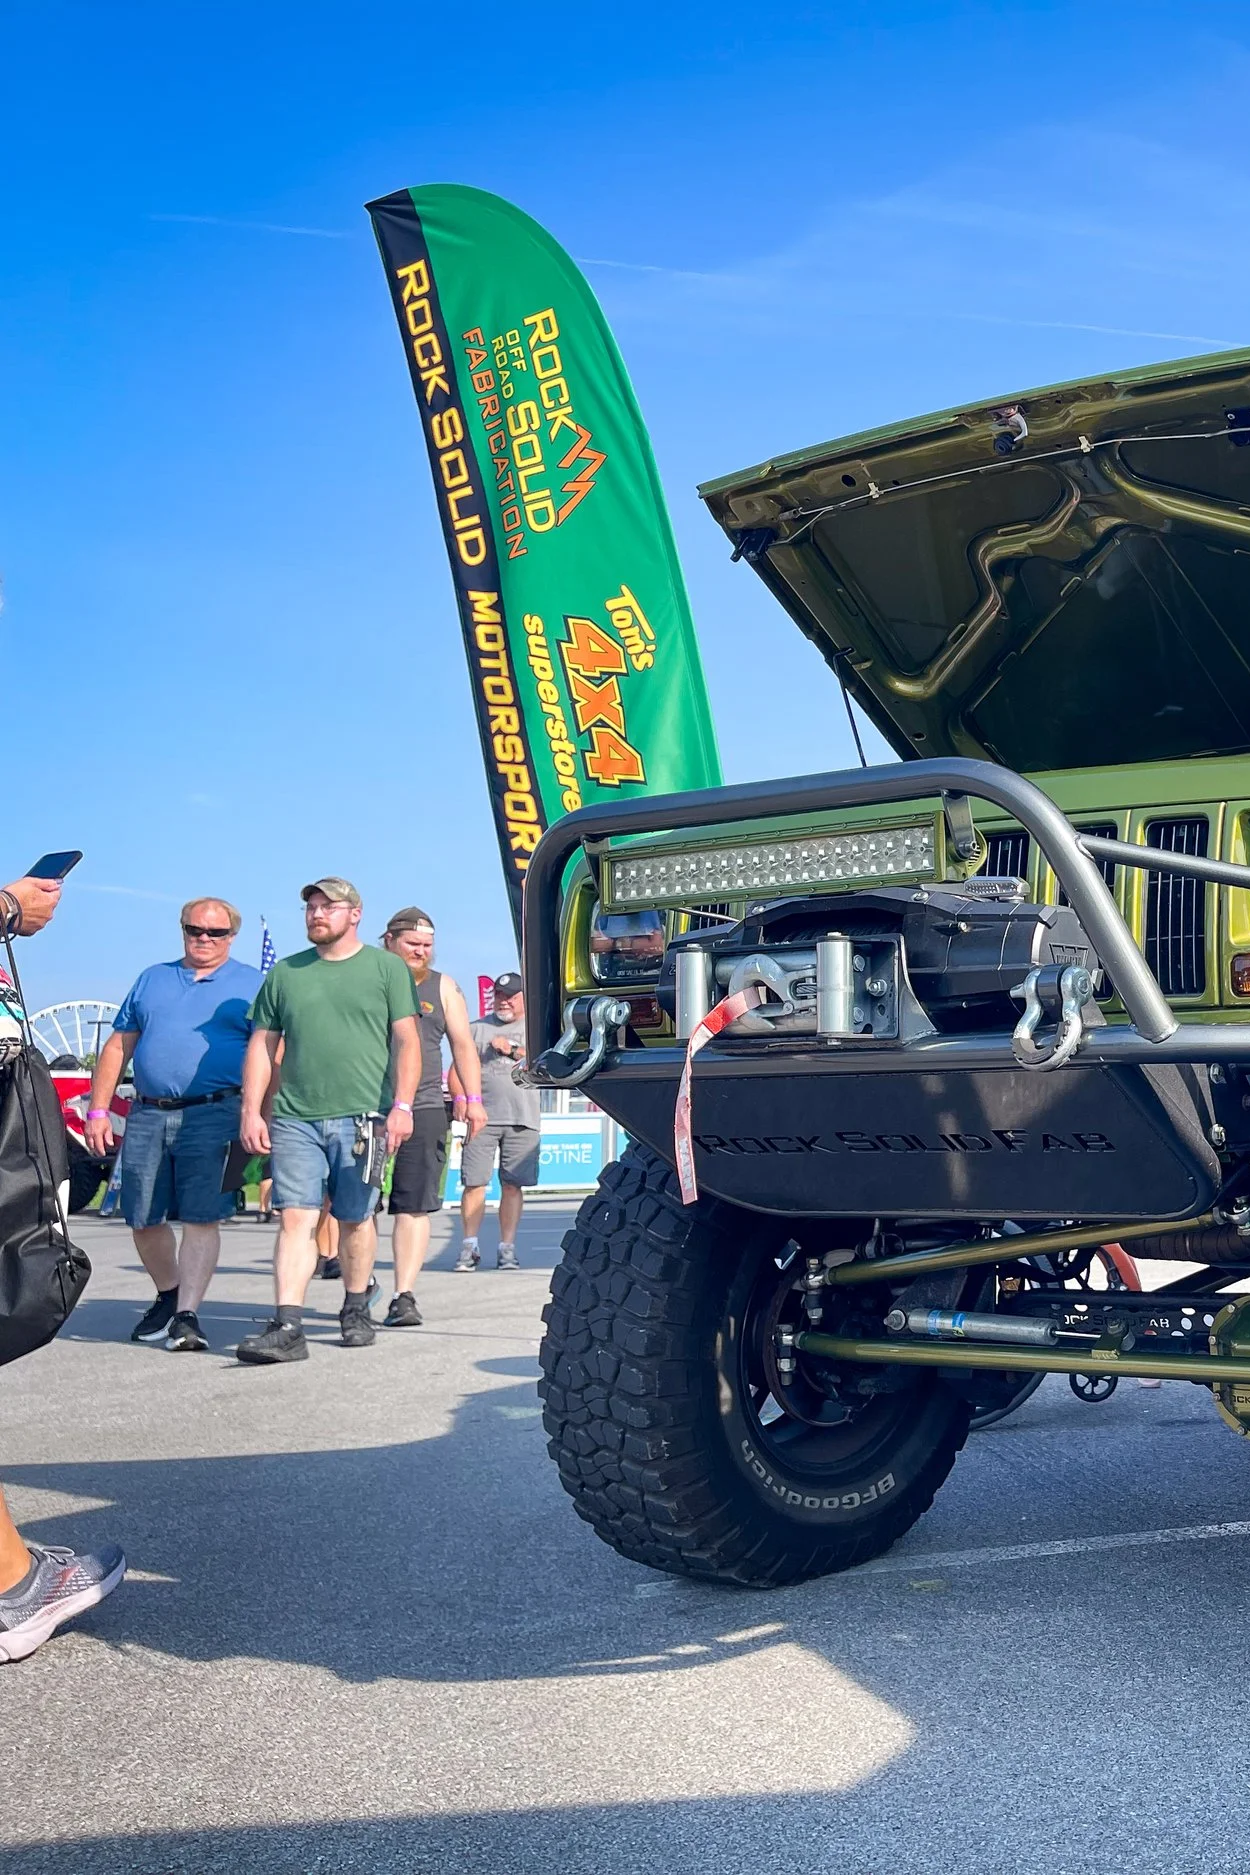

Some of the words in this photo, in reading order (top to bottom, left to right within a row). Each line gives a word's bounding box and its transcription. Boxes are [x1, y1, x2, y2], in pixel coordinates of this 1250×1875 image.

[491, 336, 515, 398] ROAD
[506, 329, 527, 371] OFF
[523, 307, 577, 443] ROCK
[462, 327, 529, 560] FABRICATION
[507, 400, 556, 533] SOLID
[396, 259, 449, 406] ROCK
[431, 406, 487, 566] SOLID
[467, 590, 546, 882] MOTORSPOR
[604, 583, 656, 672] Tom's
[522, 613, 582, 812] superstore
[538, 1150, 593, 1165] OTINE
[693, 1134, 839, 1157] ROCK
[833, 1131, 992, 1154] SOLID
[994, 1129, 1116, 1154] FAB
[740, 1439, 896, 1510] BFGoodrich
